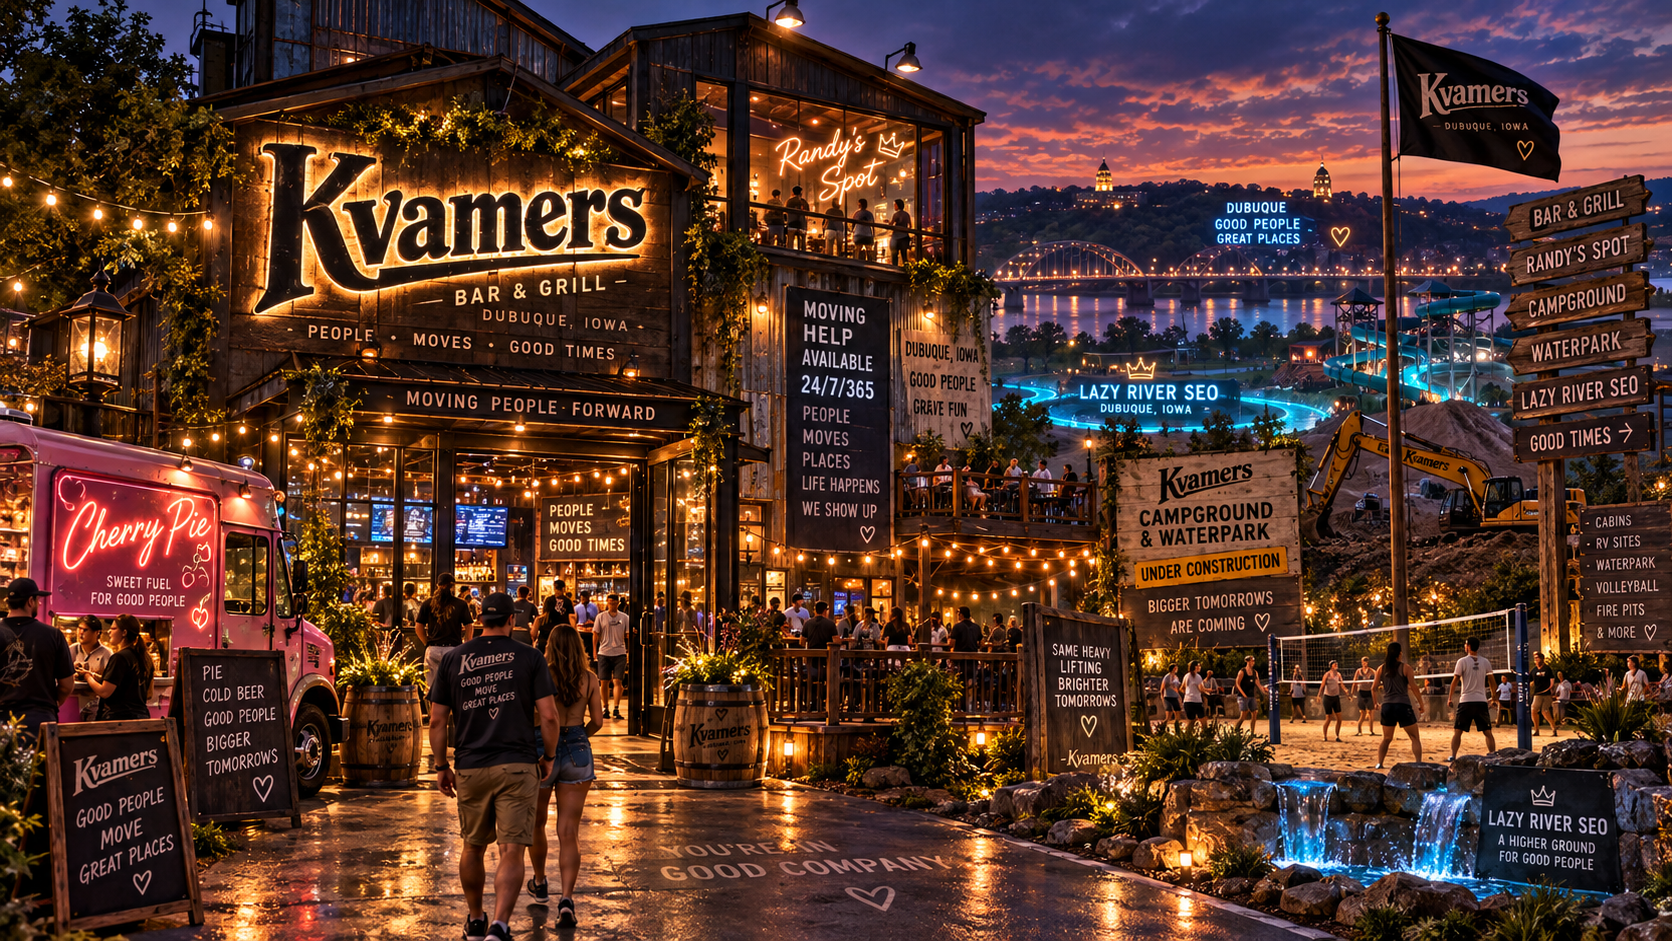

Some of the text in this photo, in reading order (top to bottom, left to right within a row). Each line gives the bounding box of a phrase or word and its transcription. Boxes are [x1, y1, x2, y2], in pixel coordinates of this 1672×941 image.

[1417, 72, 1529, 119] Kvamers
[1445, 122, 1529, 132] DUBUQUE, IOWA
[775, 127, 866, 176] Randy's
[819, 158, 886, 205] Spot
[1227, 202, 1286, 214] DUBUQUE
[1534, 189, 1624, 227] BAR & GRILL
[253, 142, 647, 314] Kvamers
[1215, 218, 1300, 230] GOOD PEOPLE
[1217, 233, 1300, 244] GREAT PLACES
[1526, 235, 1630, 273] RANDY'S SPOT
[455, 275, 606, 306] BAR & GRILL
[1529, 283, 1626, 318] CAMPGROUND
[482, 308, 628, 332] DUBUQUE, IOWA
[804, 300, 866, 325] MOVING
[308, 324, 615, 360] PEOPLE MOVES GOOD TIMES
[804, 324, 853, 346] HELP
[905, 340, 979, 364] DUBUQUE, IOWA
[1531, 331, 1621, 362] WATERPARK
[802, 349, 873, 372] AVAILABLE
[801, 375, 874, 400] 24/7/365
[910, 371, 976, 392] GOOD PEOPLE
[1080, 384, 1218, 401] LAZY RIVER SEO
[1521, 375, 1638, 410] LAZY RIVER SEO
[406, 390, 655, 421] MOVING PEOPLE FORWARD
[803, 405, 850, 424] PEOPLE
[948, 401, 967, 418] FUN
[1100, 403, 1192, 415] DUBUQUE, IOWA
[803, 429, 849, 446] MOVES
[1530, 427, 1611, 452] GOOD TIMES
[802, 451, 850, 470] PLACES
[802, 475, 880, 494] LIFE HAPPENS
[1157, 463, 1253, 505] Kvamers
[550, 503, 593, 517] PEOPLE
[802, 501, 877, 519] WE SHOW UP
[1139, 502, 1273, 527] CAMPGROUND
[550, 520, 591, 534] MOVES
[1595, 515, 1632, 528] CABINS
[63, 498, 211, 570] Cherry Pie
[1140, 523, 1270, 547] & WATERPARK
[1596, 535, 1641, 549] RV SITES
[549, 538, 625, 552] GOOD TIMES
[1141, 552, 1280, 582] UNDER CONSTRUCTION
[1596, 557, 1656, 571] WATERPARK
[106, 575, 171, 590] SWEET FUEL
[1596, 579, 1659, 594] VOLLEYBALL
[90, 592, 185, 607] FOR GOOD PEOPLE
[1148, 590, 1274, 614] BIGGER TOMORROWS
[1597, 603, 1645, 617] FIRE PITS
[1170, 616, 1245, 635] ARE COMING
[1597, 626, 1636, 639] & MORE
[1052, 643, 1111, 660] SAME HEAVY
[203, 665, 223, 681] PIE
[458, 652, 515, 675] Kvamers
[1060, 660, 1102, 674] LIFTING
[460, 670, 513, 688] GOOD PEOPLE
[1058, 677, 1109, 691] BRIGHTER
[203, 685, 265, 703] COLD BEER
[462, 691, 515, 710] GREAT PLACES
[475, 684, 497, 696] MOVE
[1055, 694, 1117, 708] TOMORROWS
[204, 707, 276, 727] GOOD PEOPLE
[206, 731, 251, 752] BIGGER
[689, 723, 751, 749] Kvamers
[72, 748, 159, 797] Kvamers
[206, 748, 279, 776] TOMORROWS
[76, 787, 164, 828] GOOD PEOPLE
[1488, 809, 1608, 836] LAZY RIVER SEO
[100, 817, 143, 850] MOVE
[1498, 834, 1596, 854] A HIGHER GROUND
[658, 839, 839, 858] YOU'RE IN
[79, 834, 174, 885] GREAT PLACES
[661, 855, 952, 882] GOOD COMPANY
[1499, 850, 1594, 871] FOR GOOD PEOPLE
